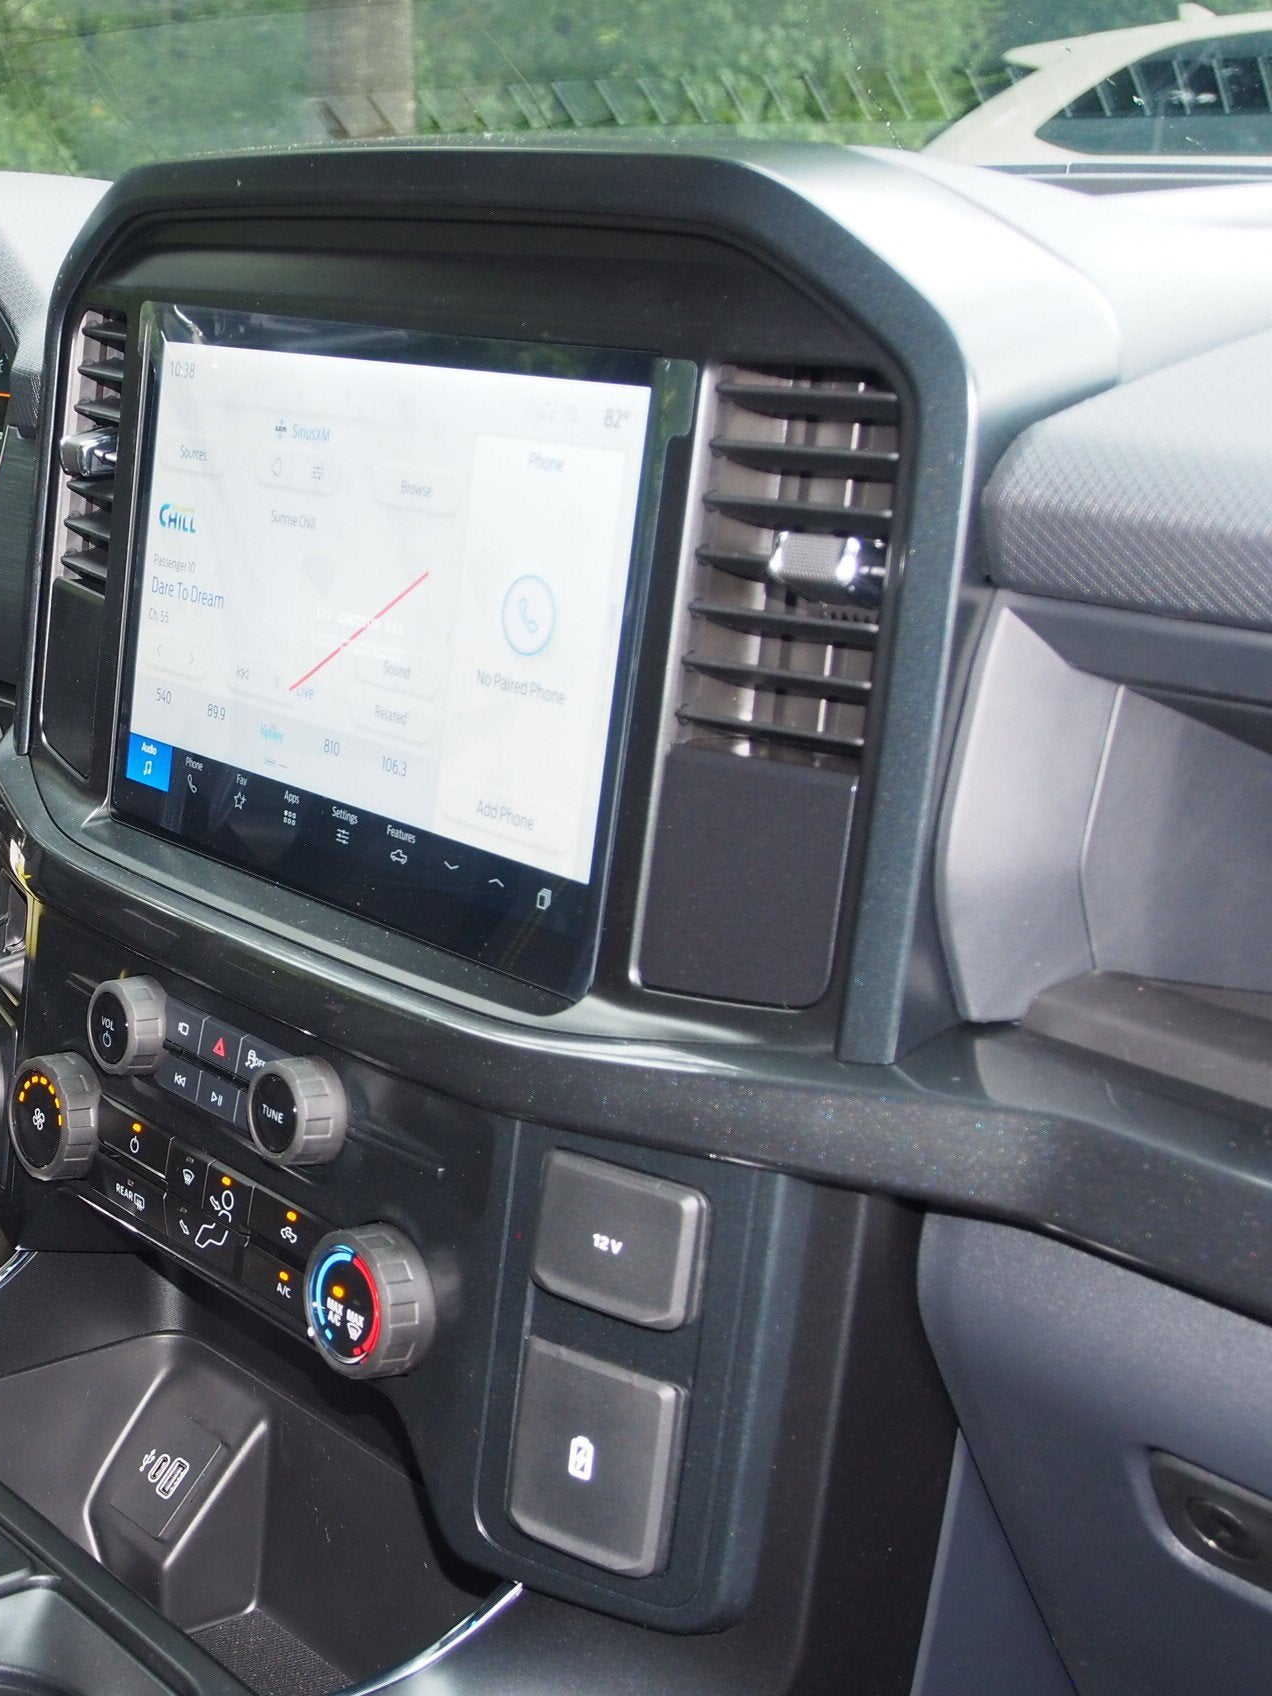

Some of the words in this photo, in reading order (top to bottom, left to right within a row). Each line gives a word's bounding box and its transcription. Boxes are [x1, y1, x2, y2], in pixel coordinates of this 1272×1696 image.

[170, 361, 195, 379] 10:38
[292, 423, 330, 443] SiriusXM
[179, 444, 207, 462] Sources
[528, 451, 565, 474] Phone
[399, 479, 432, 498] Browse
[270, 509, 297, 528] Sunrise
[298, 513, 316, 530] Chill
[153, 553, 187, 573] Passenger
[187, 561, 196, 574] 10
[151, 575, 174, 598] Dare
[176, 581, 189, 601] To
[190, 584, 225, 610] Dream
[383, 660, 411, 680] Sound
[156, 687, 172, 704] 540
[475, 669, 490, 688] No
[493, 673, 528, 697] Paired
[529, 681, 567, 706] Phone
[207, 703, 226, 720] 89.9
[374, 704, 408, 725] Related
[141, 742, 157, 756] Audio
[323, 738, 341, 756] 810
[185, 756, 204, 772] Phone
[382, 756, 408, 777] 106.3
[236, 773, 247, 786] Fav
[283, 790, 300, 804] Apps
[331, 805, 358, 826] Settings
[476, 800, 497, 820] Add
[500, 806, 535, 831] Phone
[386, 824, 416, 844] Features
[101, 1015, 115, 1032] VOL
[262, 1103, 284, 1124] TUNE
[115, 1182, 133, 1202] REAR
[276, 1282, 291, 1299] A/C
